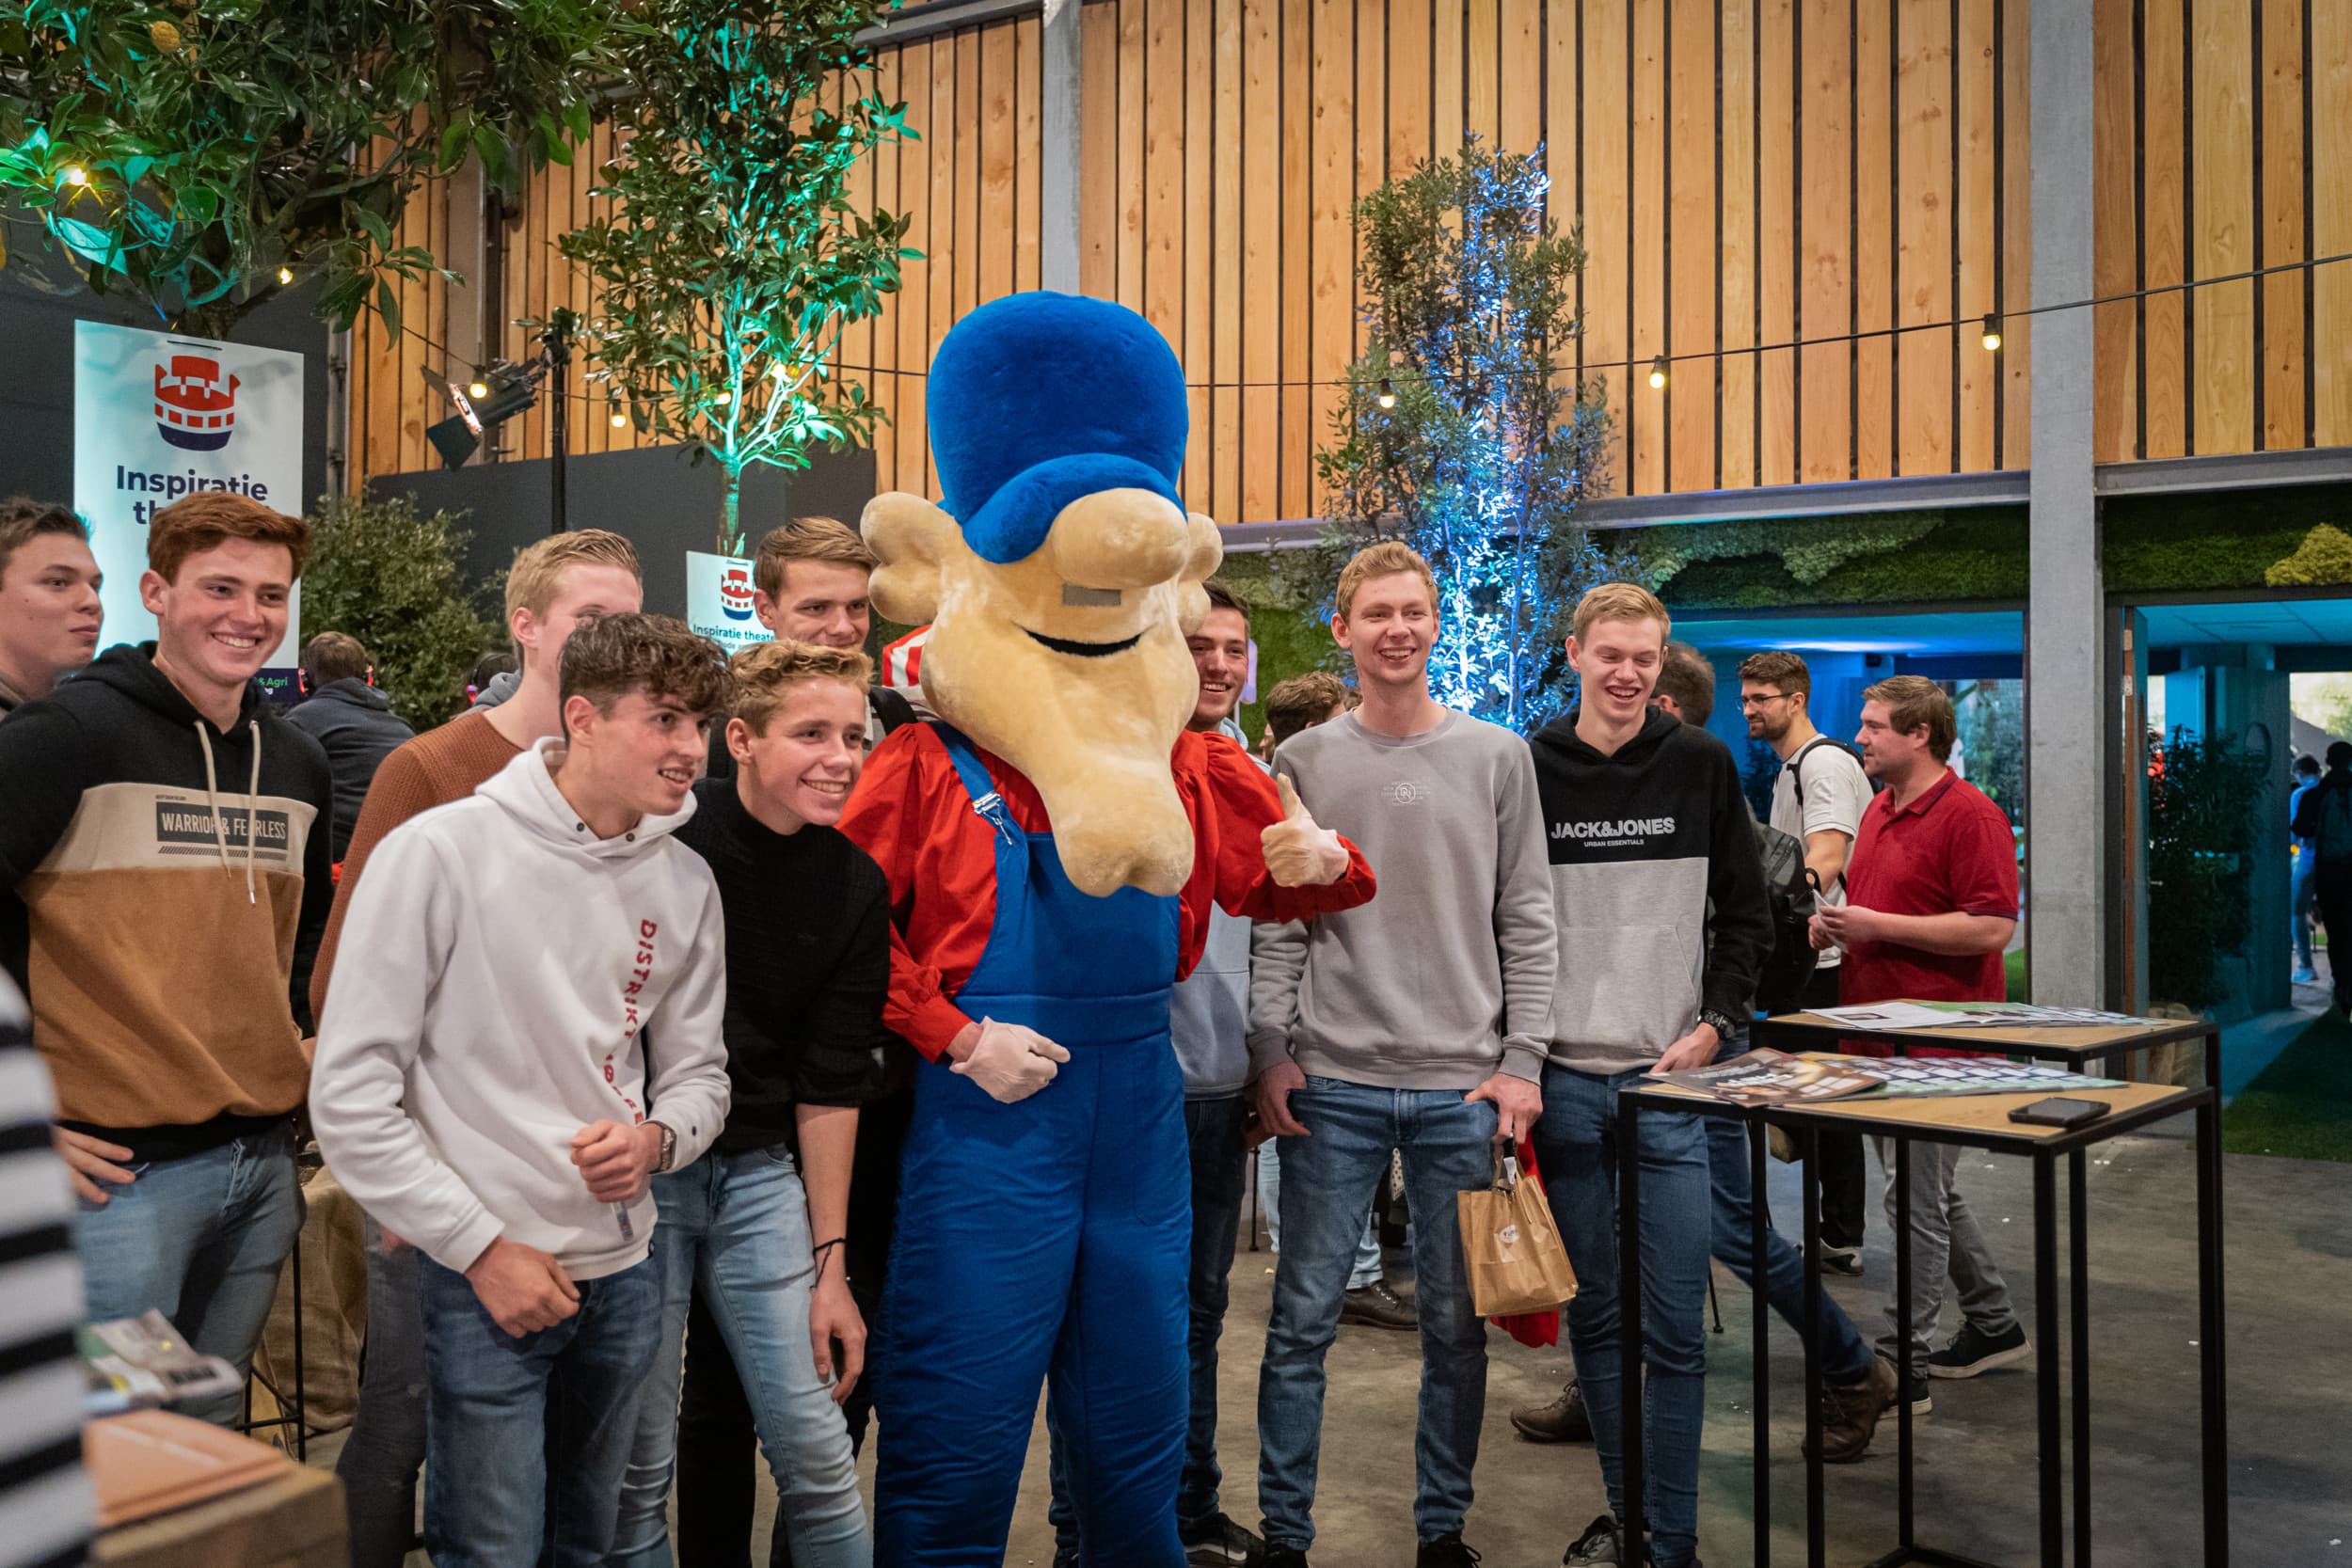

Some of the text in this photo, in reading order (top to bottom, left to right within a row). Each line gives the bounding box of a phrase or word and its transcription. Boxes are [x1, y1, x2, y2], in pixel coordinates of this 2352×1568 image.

[117, 466, 268, 500] Inspiratie
[693, 625, 775, 641] Inspiratie theate
[266, 676, 288, 689] Agri
[233, 817, 286, 840] FERLESS
[1550, 816, 1676, 838] JACK&JONES
